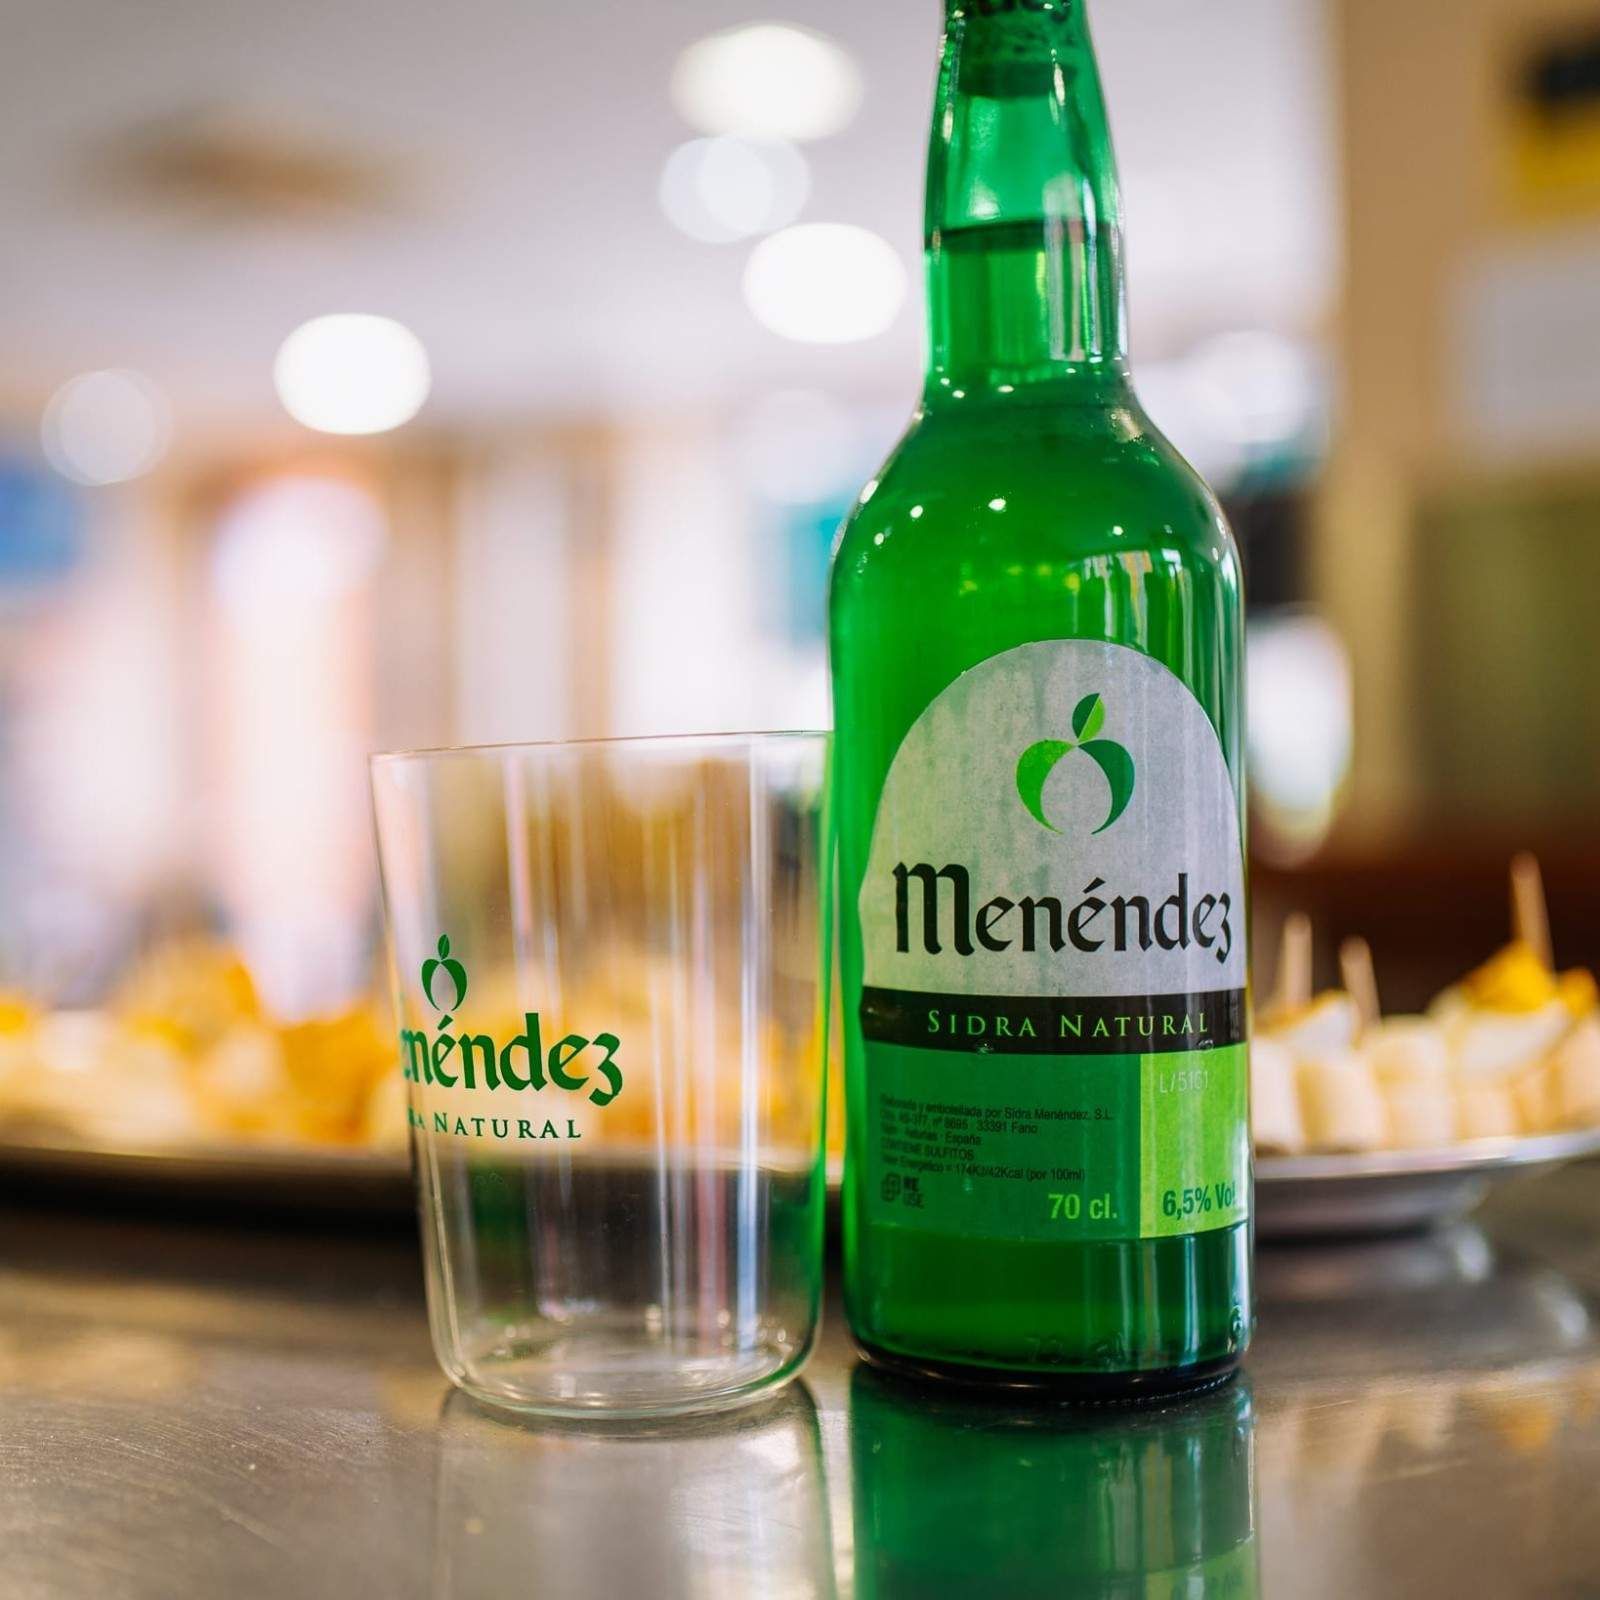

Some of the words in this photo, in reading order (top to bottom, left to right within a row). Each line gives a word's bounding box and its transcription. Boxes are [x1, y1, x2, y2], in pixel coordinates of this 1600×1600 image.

[892, 862, 1231, 964] Menéndez
[928, 1010, 1037, 1037] SIDRA
[1060, 1011, 1208, 1038] NATURAL
[401, 1013, 623, 1106] néndez
[434, 1112, 582, 1139] NATURAL
[985, 1108, 1001, 1120] por
[1004, 1106, 1033, 1120] Sidra
[945, 1131, 982, 1146] España
[1011, 1121, 1038, 1134] Fano
[925, 1145, 975, 1160] SULFITOS
[1027, 1168, 1047, 1182] (por
[1051, 1168, 1085, 1181] 100ml)
[1047, 1194, 1081, 1220] 70
[1089, 1193, 1118, 1219] cl.
[1162, 1184, 1212, 1221] 6,5%
